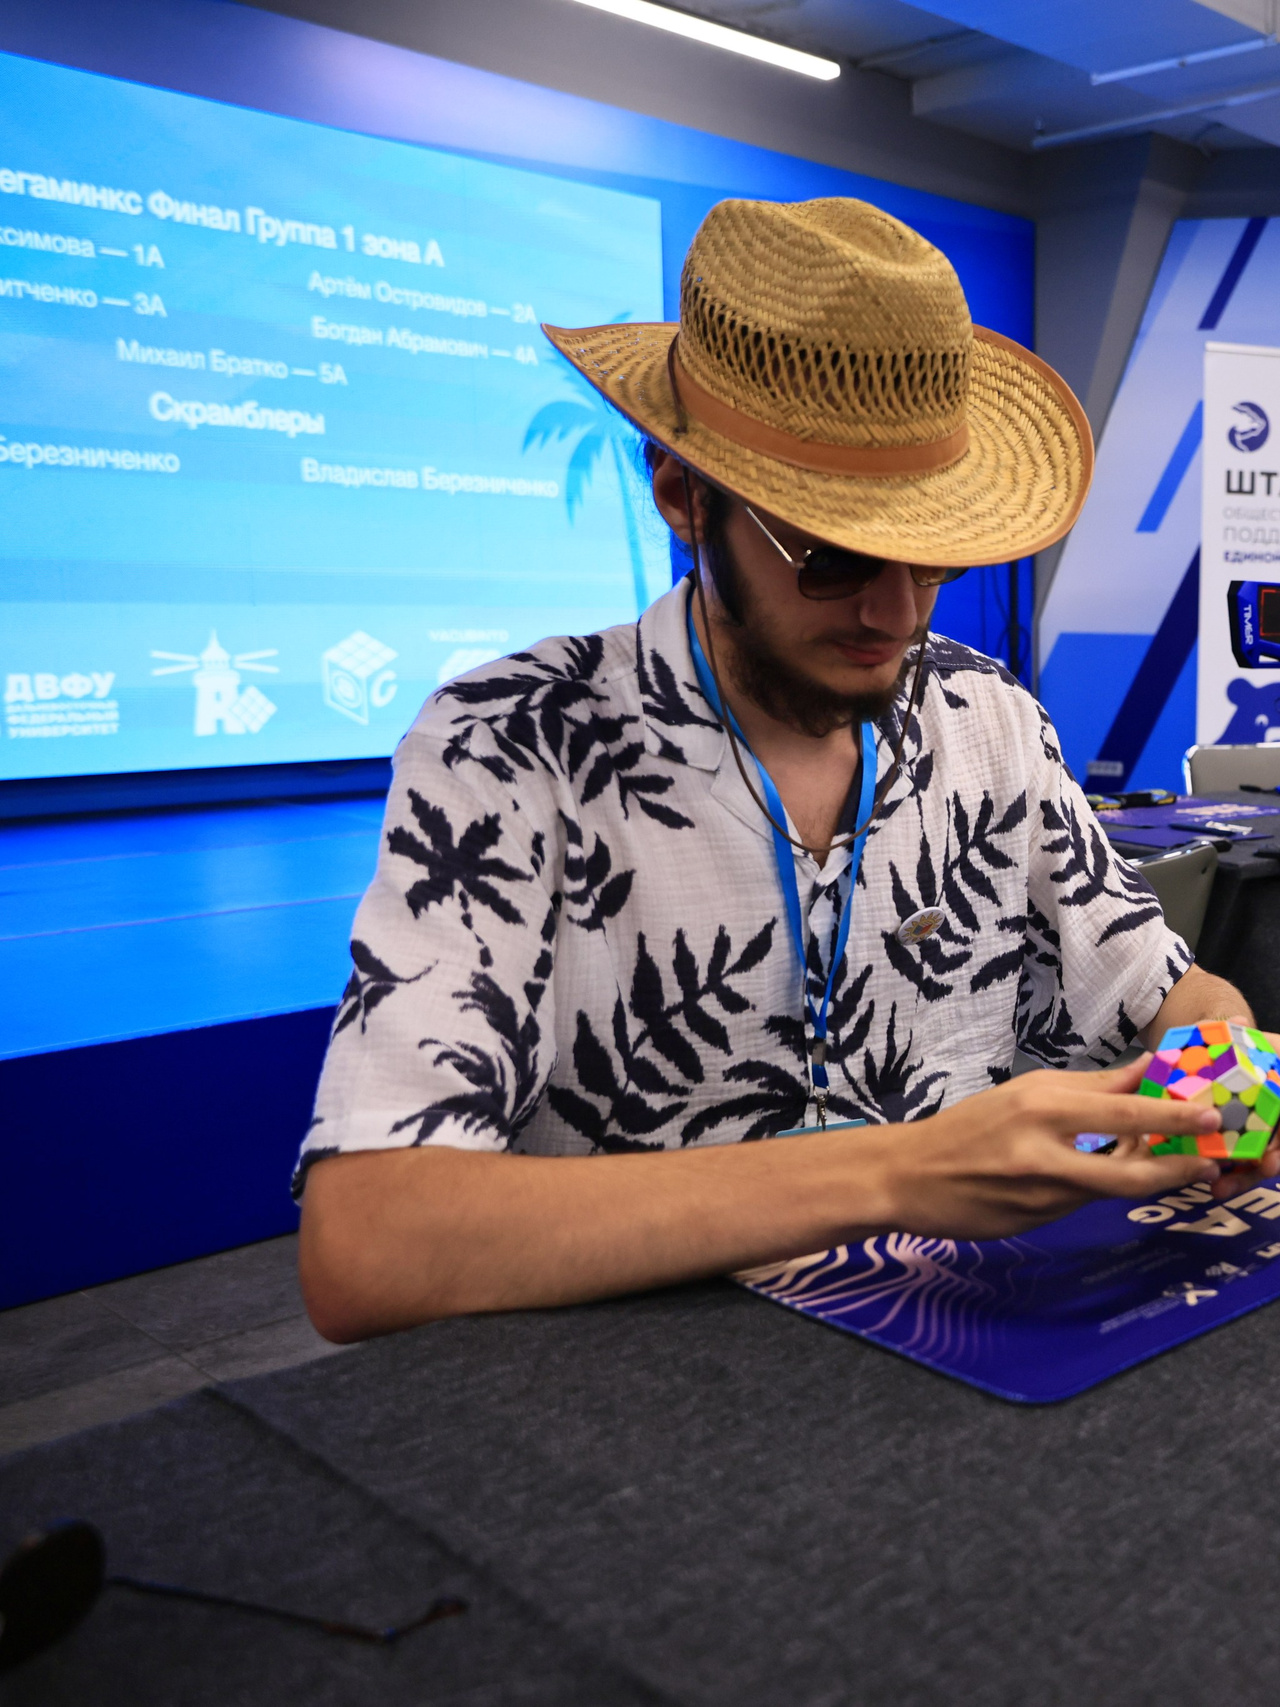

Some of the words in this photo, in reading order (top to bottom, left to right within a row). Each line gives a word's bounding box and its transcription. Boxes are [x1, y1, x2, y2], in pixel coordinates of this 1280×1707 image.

[147, 190, 241, 233] Финал
[245, 206, 337, 247] Группа
[342, 225, 356, 252] 1
[362, 233, 421, 264] зона
[308, 271, 371, 299] Артём
[312, 316, 383, 346] Богдан
[387, 327, 488, 354] Абрамович
[115, 337, 206, 370] Михаил
[208, 348, 289, 378] Братко
[149, 391, 326, 438] Скрамблеры
[301, 457, 418, 488] Владислав
[421, 466, 559, 498] Березниченко
[4, 671, 116, 703] ДВФУ
